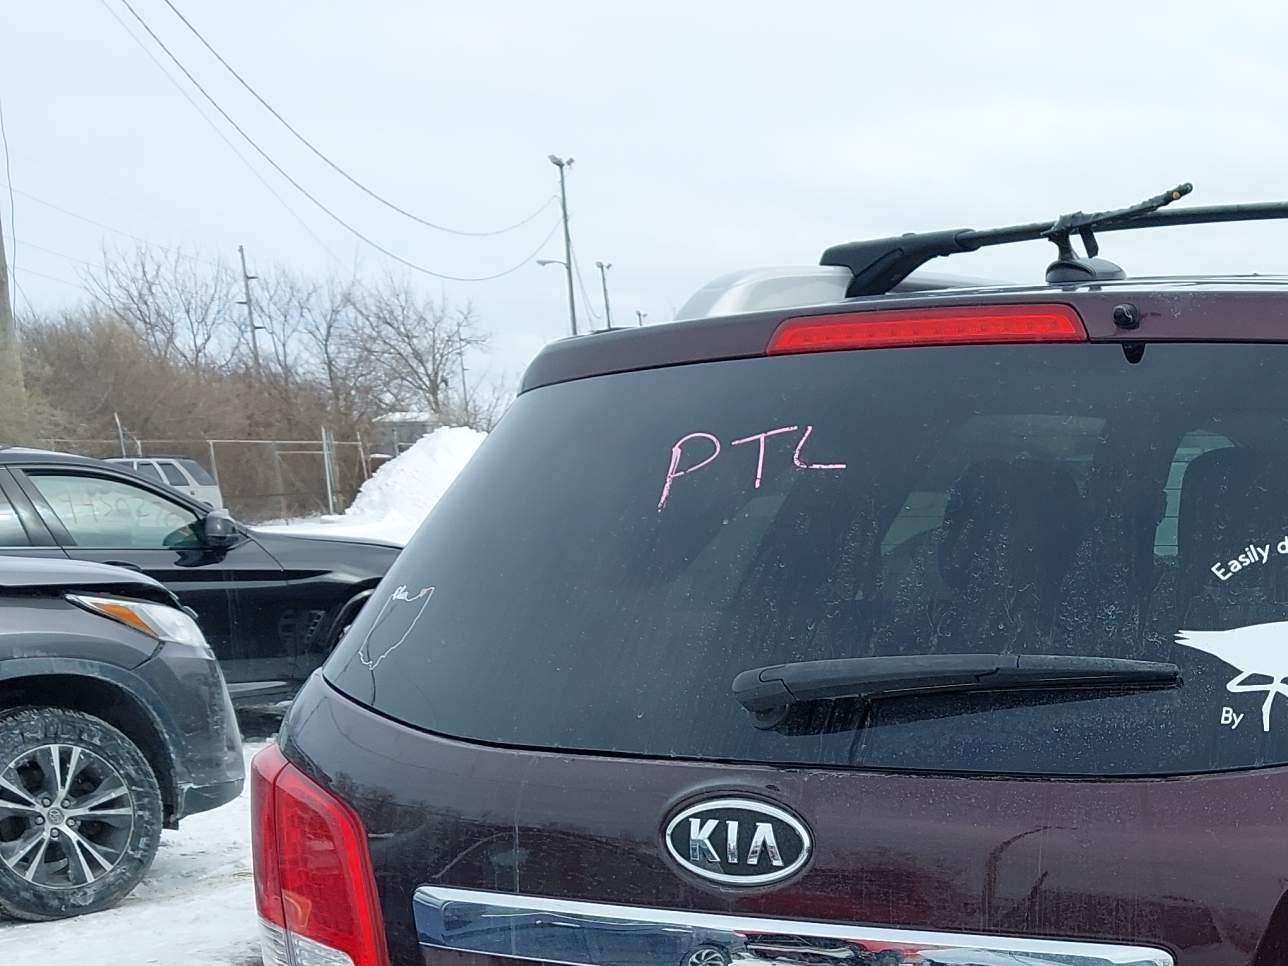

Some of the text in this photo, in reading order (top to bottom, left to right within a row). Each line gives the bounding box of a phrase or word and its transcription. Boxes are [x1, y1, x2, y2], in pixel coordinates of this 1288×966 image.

[658, 426, 846, 512] PTL
[1211, 544, 1270, 581] Easily
[1220, 706, 1244, 730] By
[689, 818, 784, 867] KIA
